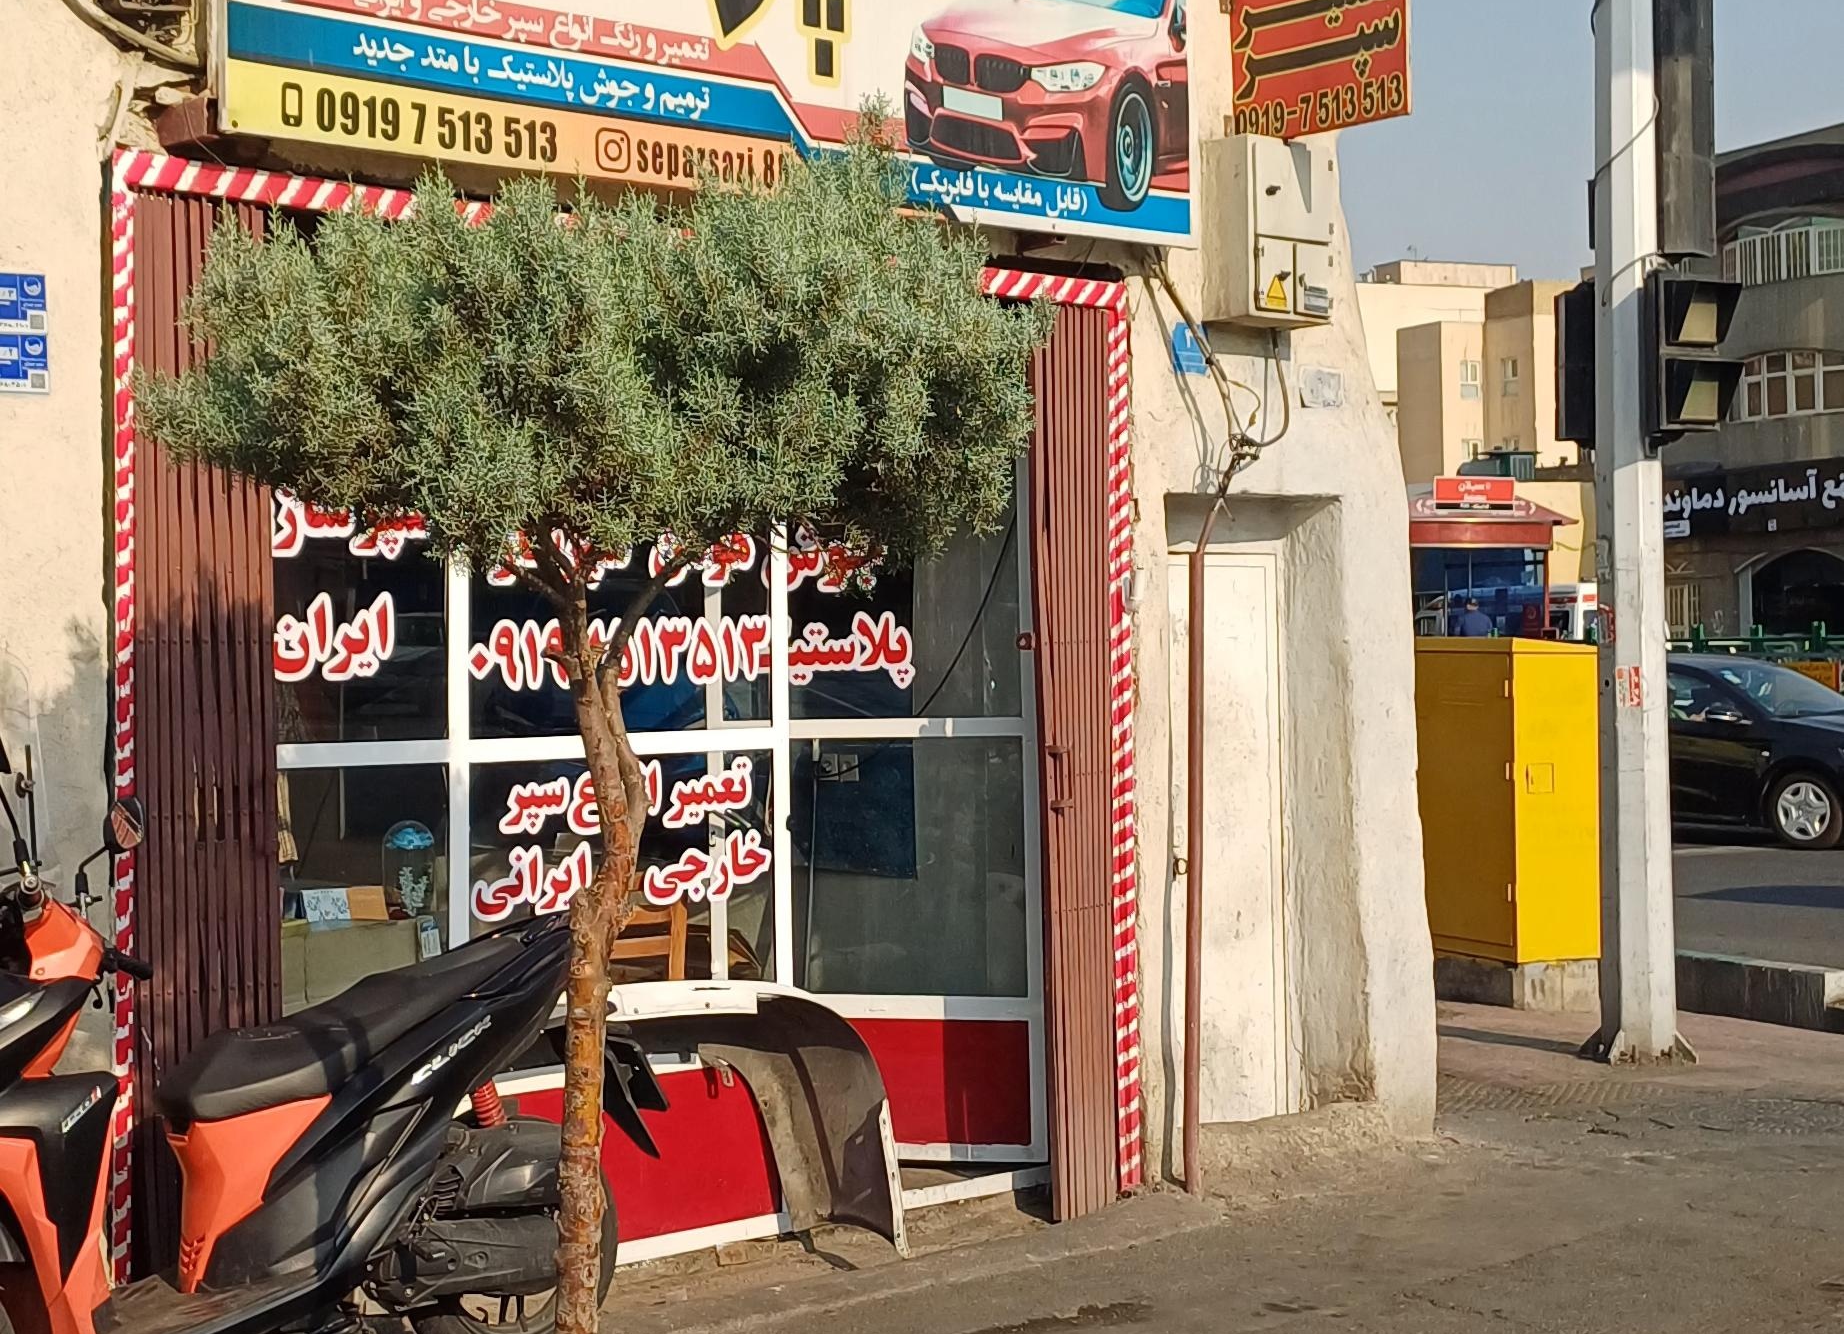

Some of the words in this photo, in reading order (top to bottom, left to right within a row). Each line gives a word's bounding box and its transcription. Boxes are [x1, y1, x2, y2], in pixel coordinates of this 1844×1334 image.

[502, 13, 546, 43] سپر
[549, 10, 595, 52] انواع
[600, 22, 643, 57] رنگ
[646, 32, 657, 59] و
[661, 35, 711, 65] تعمیر
[352, 31, 415, 73] جدید
[420, 44, 460, 75] متد
[463, 45, 480, 84] با
[1233, 7, 1401, 104] سپر
[487, 54, 574, 104] پلاستیک
[579, 68, 640, 108] جوش
[644, 82, 655, 110] و
[1316, 82, 1358, 128] 513
[1361, 70, 1405, 118] 513
[316, 86, 402, 142] 0919
[411, 101, 428, 145] 7
[437, 106, 494, 160] 513
[503, 115, 558, 164] 513
[660, 86, 711, 119] ترمیم
[977, 173, 990, 207] با
[993, 178, 1042, 210] مقایسه
[1727, 468, 1818, 516] آسانسور
[271, 487, 357, 558] ساز
[274, 590, 395, 682] ایران
[759, 610, 916, 690] پلاستی
[499, 776, 570, 835] سپر
[662, 756, 753, 828] تعمیر
[471, 840, 593, 923] ایرانی
[644, 828, 773, 905] خارجی
[410, 1014, 492, 1085] CLICK
